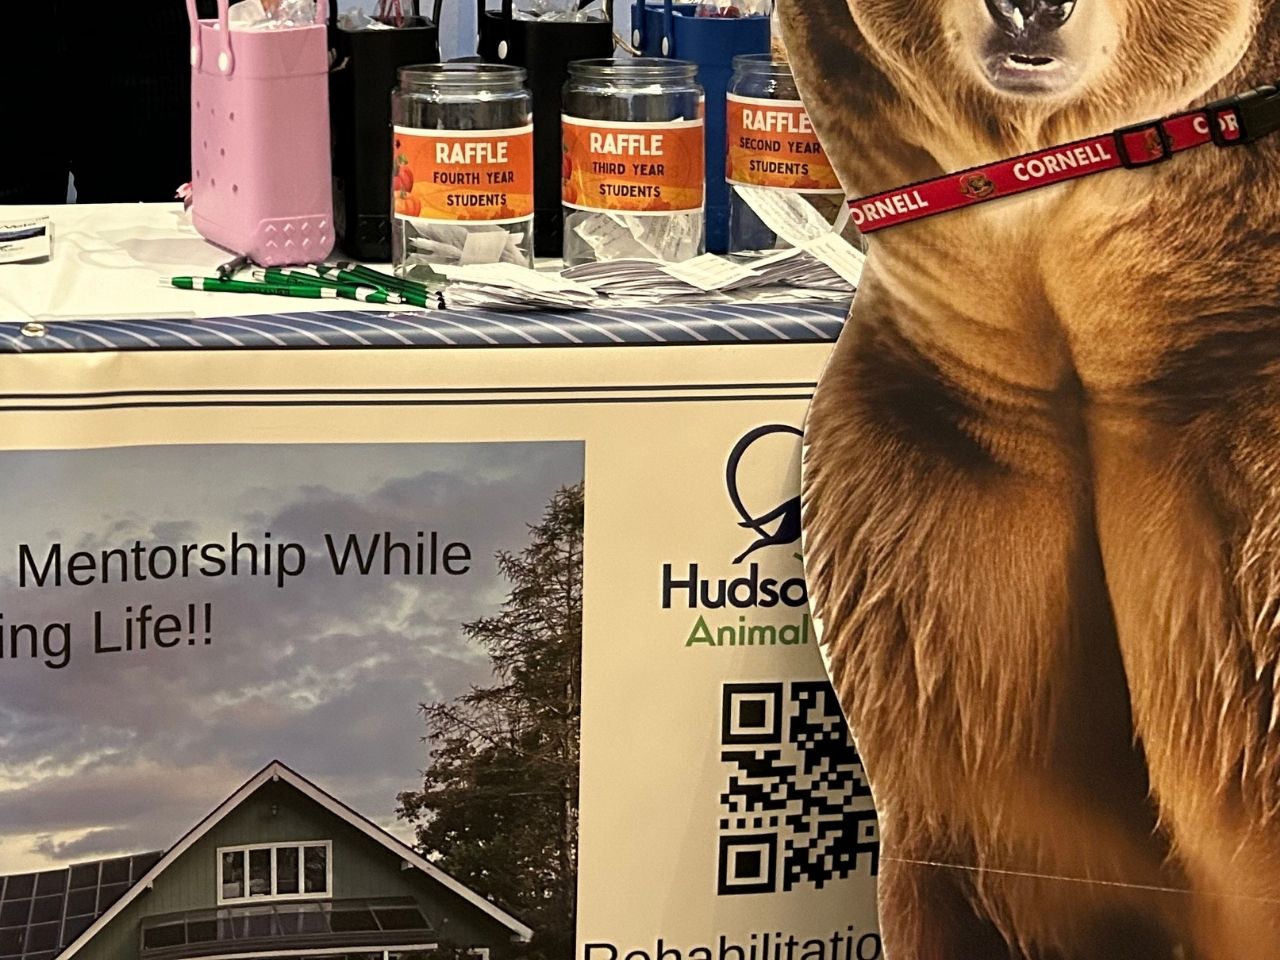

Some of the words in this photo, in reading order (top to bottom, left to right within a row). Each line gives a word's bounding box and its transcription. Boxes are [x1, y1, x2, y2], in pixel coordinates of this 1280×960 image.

[742, 109, 812, 134] RAFFLE
[436, 141, 508, 164] RAFFLE
[590, 133, 663, 156] RAFFLE
[739, 136, 781, 152] SECOND
[787, 141, 821, 154] YEAR
[592, 161, 628, 176] THIRD
[632, 162, 665, 176] YEAR
[749, 159, 809, 176] STUDENTS
[1012, 143, 1112, 183] CORNELL
[433, 171, 481, 185] FOURTH
[486, 170, 515, 184] YEAR
[446, 192, 507, 207] STUDENTS
[599, 183, 661, 198] STUDENTS
[18, 531, 307, 588] Mentorship
[325, 530, 473, 577] While
[662, 562, 808, 609] Hudso
[92, 602, 215, 656] Life!!
[685, 613, 809, 647] Animal
